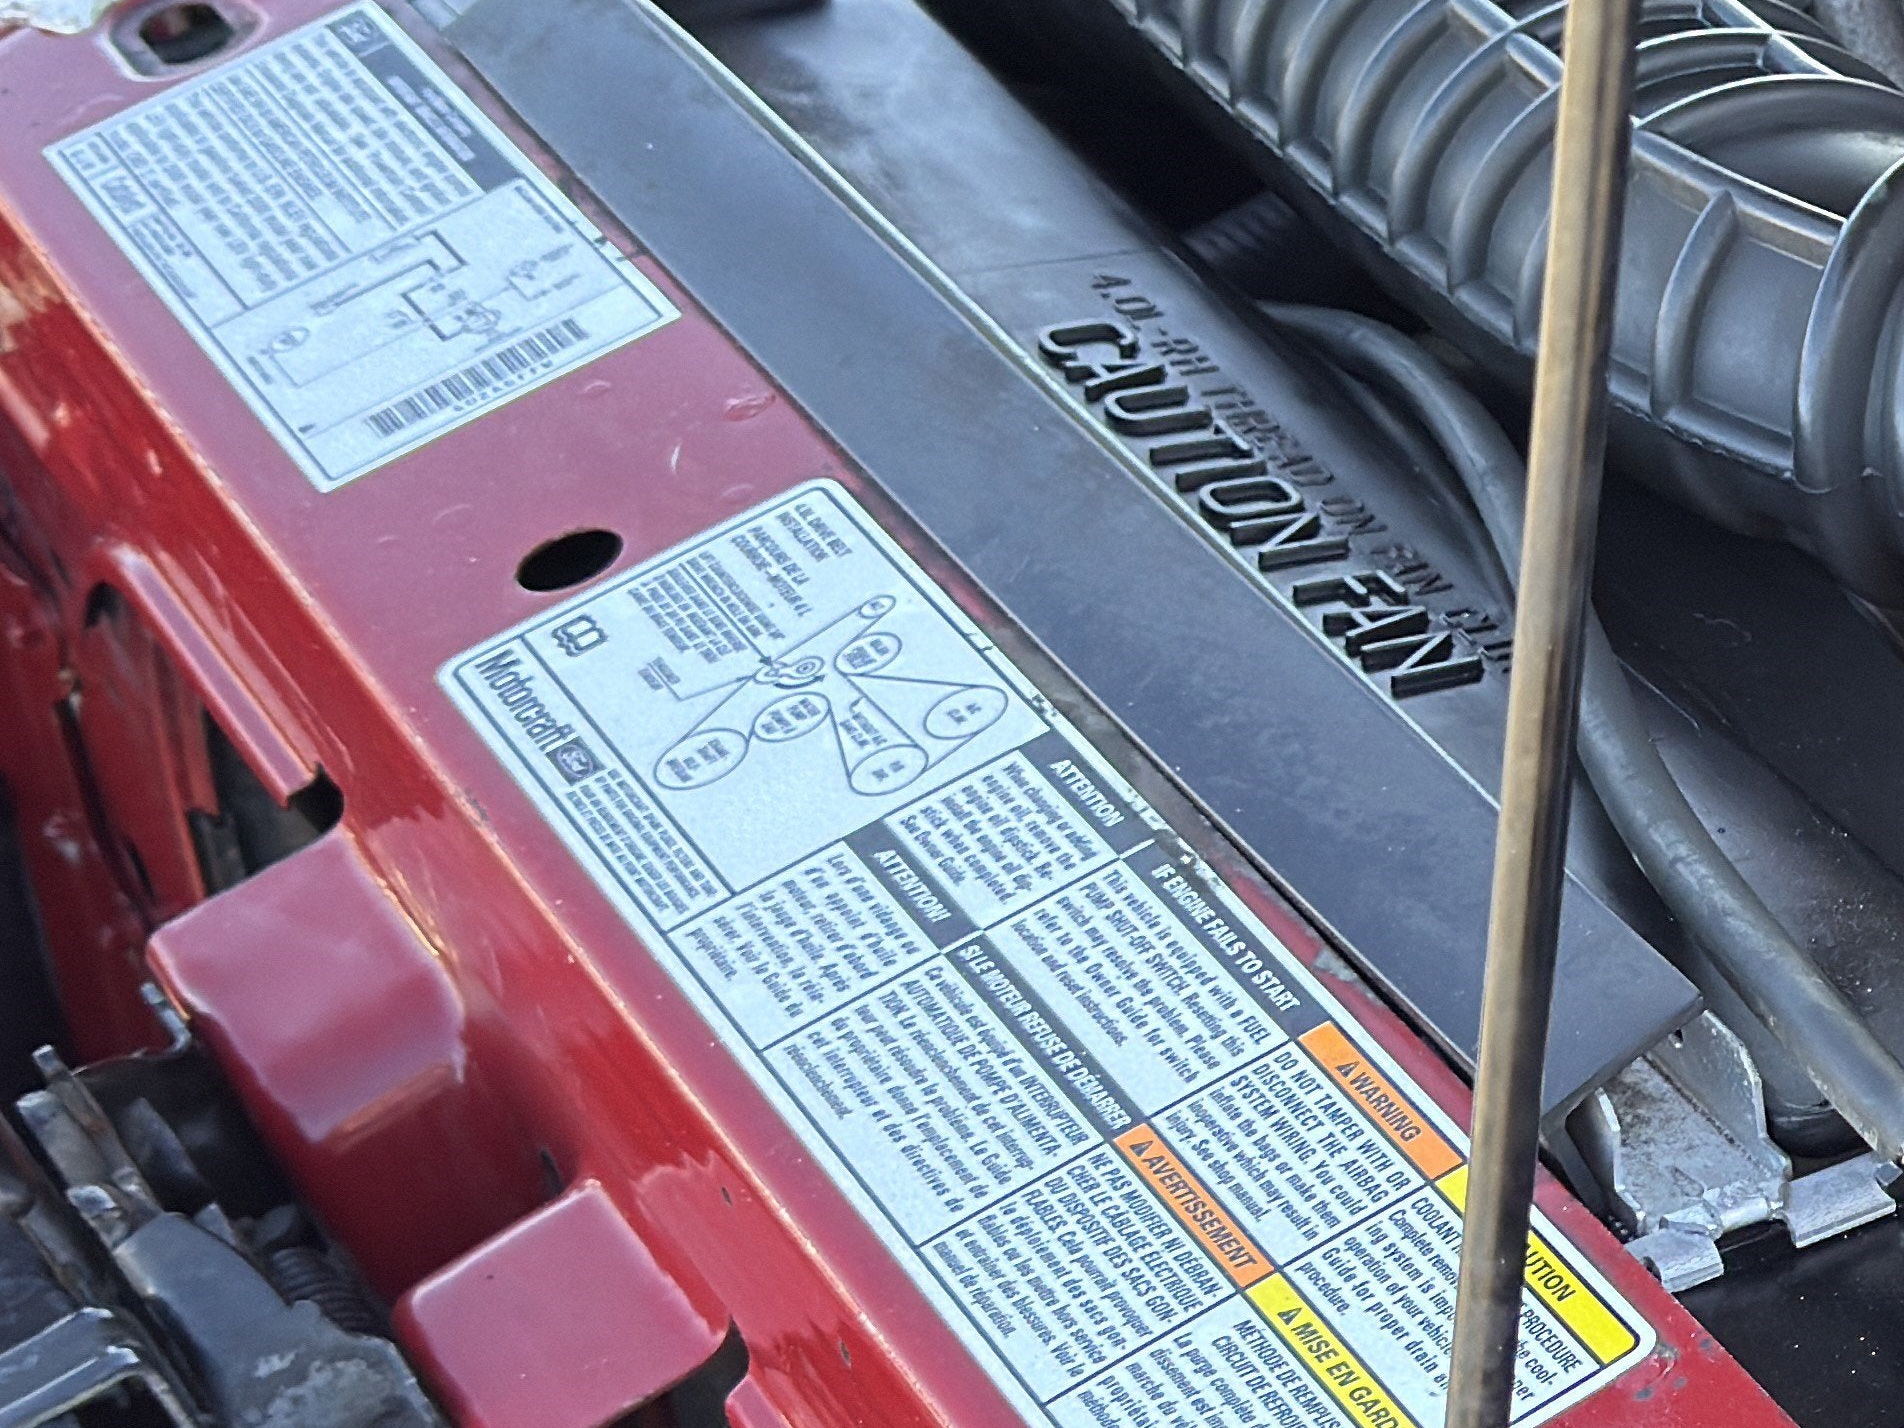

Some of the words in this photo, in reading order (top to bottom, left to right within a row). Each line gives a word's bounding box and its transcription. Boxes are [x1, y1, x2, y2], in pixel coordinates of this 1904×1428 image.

[1037, 319, 1348, 572] CAUTION
[1292, 572, 1485, 698] FAN
[474, 648, 575, 751] Motorcraft
[1049, 759, 1124, 826] ATTENTION
[1150, 863, 1175, 878] IF
[1162, 875, 1215, 923] ENGINE
[1202, 918, 1245, 955] FAILS
[1234, 950, 1262, 973] TO
[979, 968, 1031, 1016] MOTEUR
[1251, 969, 1300, 1011] START
[1017, 1011, 1066, 1055] REFUSE
[1051, 1050, 1081, 1072] DE
[1065, 1066, 1131, 1129] DÉMARRER
[1272, 1051, 1299, 1070] DO
[1289, 1069, 1323, 1095] NOT
[1313, 1093, 1364, 1141] TAMPER
[1355, 1138, 1394, 1172] WITH
[1385, 1170, 1411, 1191] OR
[1349, 1071, 1421, 1141] WARNING
[1230, 1075, 1280, 1120] SYSTEM
[1309, 1159, 1335, 1185] You
[1329, 1184, 1367, 1215] could
[1251, 1063, 1325, 1131] DISCONNECT
[1316, 1131, 1348, 1158] THE
[1338, 1158, 1389, 1203] AIRBAG
[1140, 1155, 1257, 1268] AVERTISSEMENT
[1410, 1196, 1465, 1244] COOLANT
[1520, 1256, 1576, 1301] UTION
[1210, 1335, 1259, 1377] CIRCUIT
[1244, 1374, 1272, 1393] DE
[1232, 1319, 1289, 1373] MÉTHODE
[1275, 1368, 1302, 1387] DE
[1290, 1321, 1339, 1363] MISE
[1325, 1360, 1360, 1386] EN
